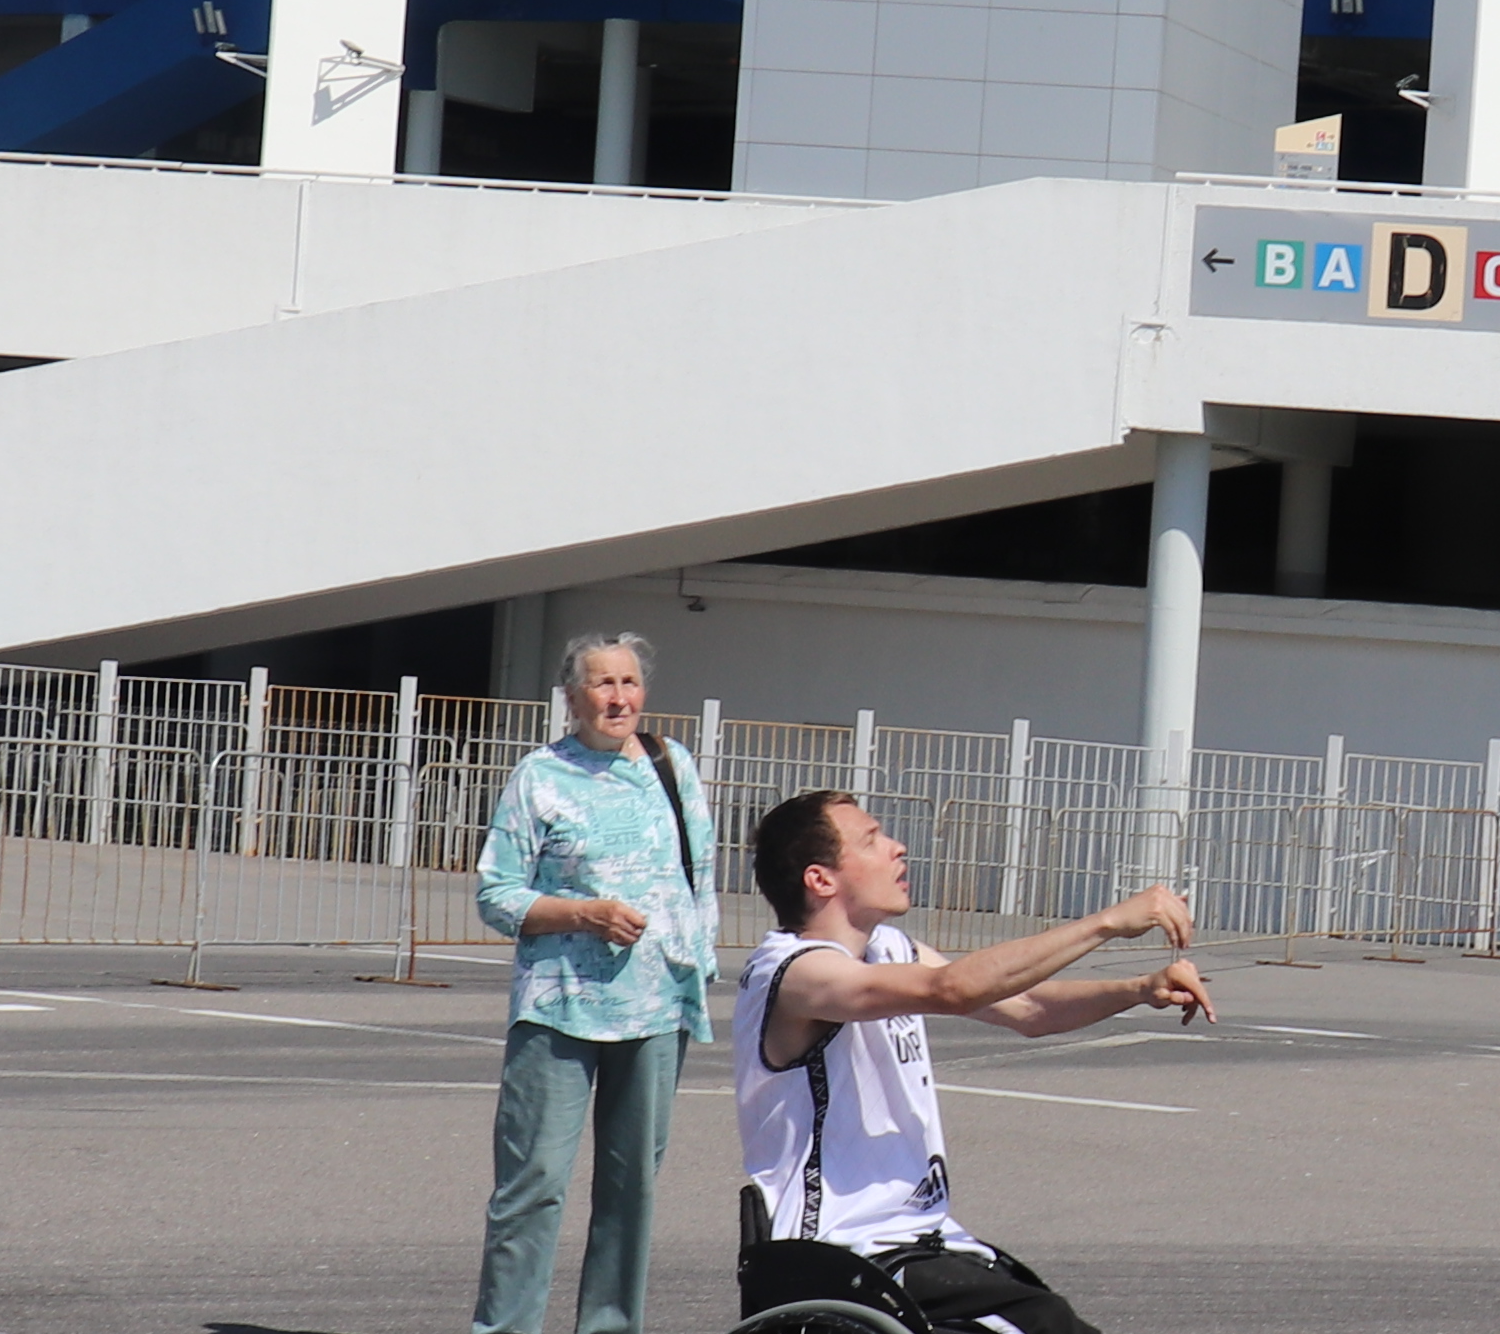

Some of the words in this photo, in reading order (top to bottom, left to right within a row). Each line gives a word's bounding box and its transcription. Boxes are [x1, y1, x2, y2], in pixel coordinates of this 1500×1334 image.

[1264, 243, 1297, 286] B
[1317, 247, 1356, 290] A
[1387, 232, 1448, 311] D
